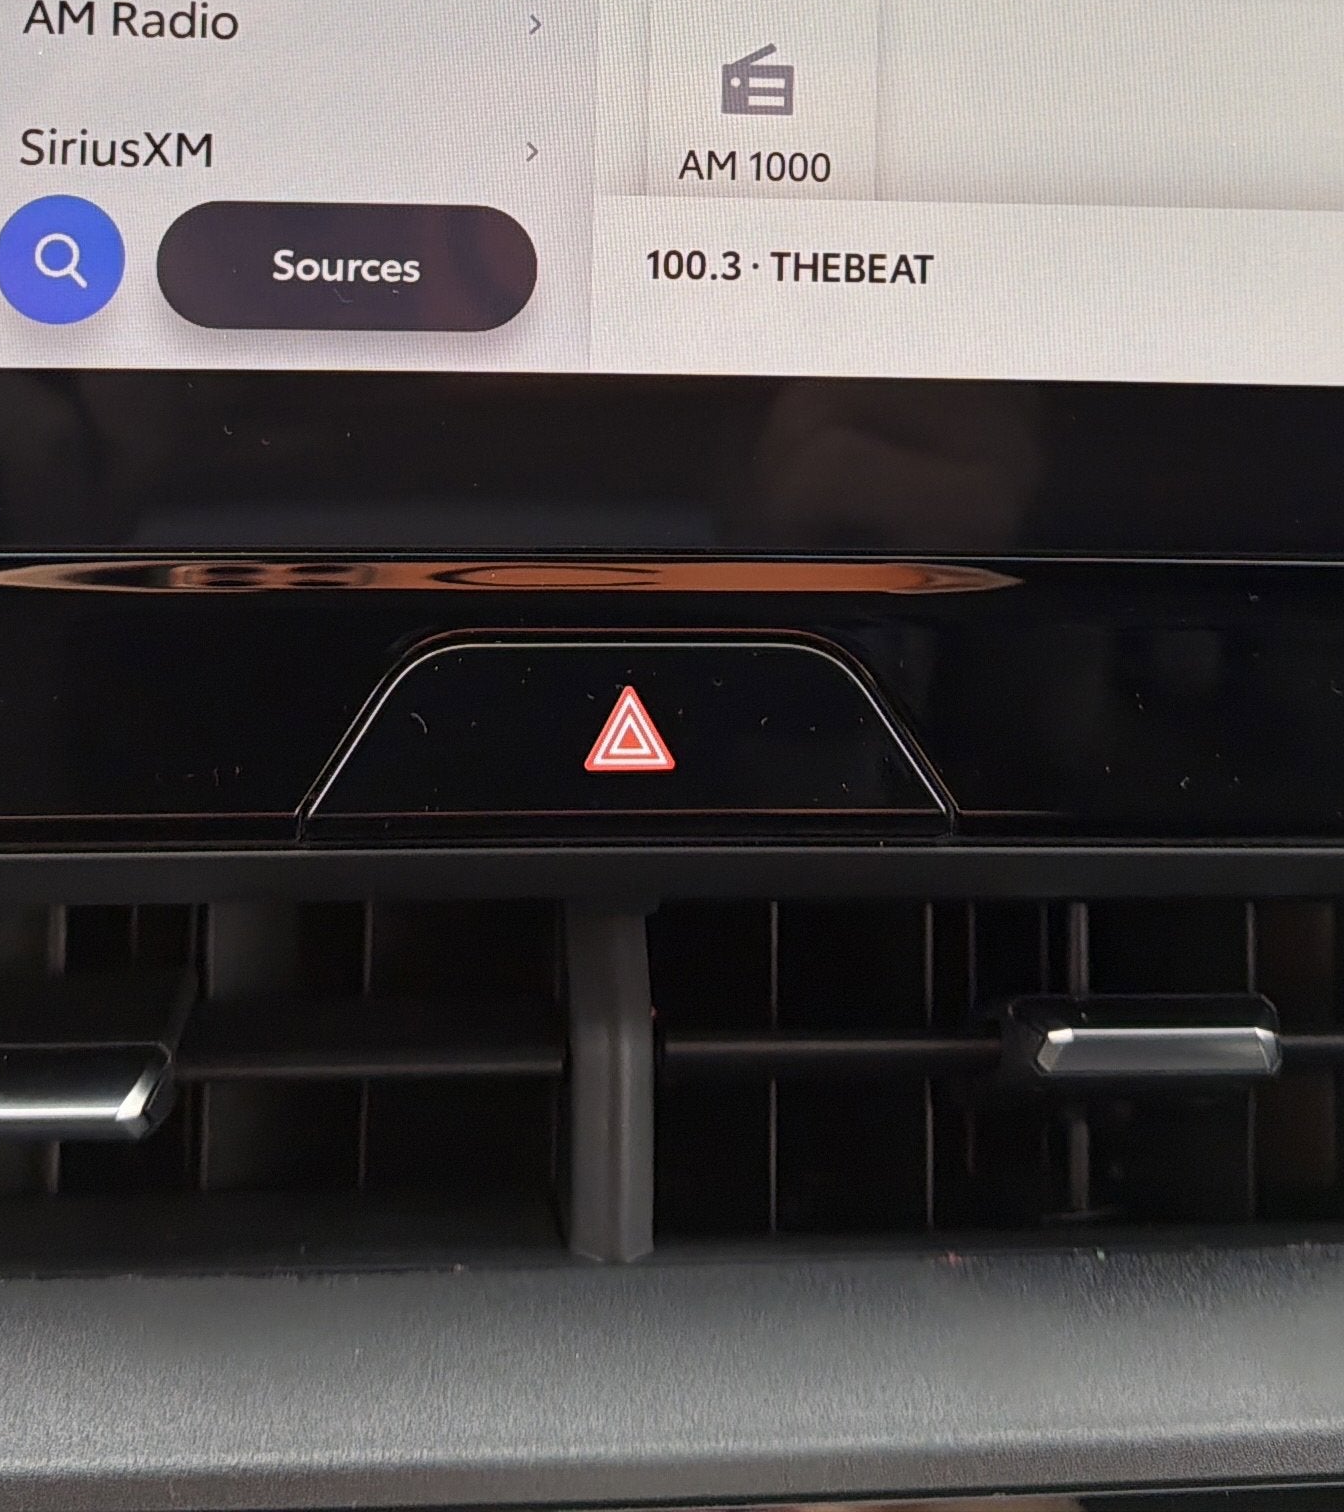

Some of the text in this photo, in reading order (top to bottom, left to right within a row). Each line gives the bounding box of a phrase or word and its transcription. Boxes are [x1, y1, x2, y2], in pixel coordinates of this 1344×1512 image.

[111, 0, 240, 41] Radio
[19, 129, 214, 169] SiriusXM
[678, 150, 832, 183] AM 1000
[272, 249, 421, 286] Sources
[646, 250, 935, 285] 100.3 THEBEAT
